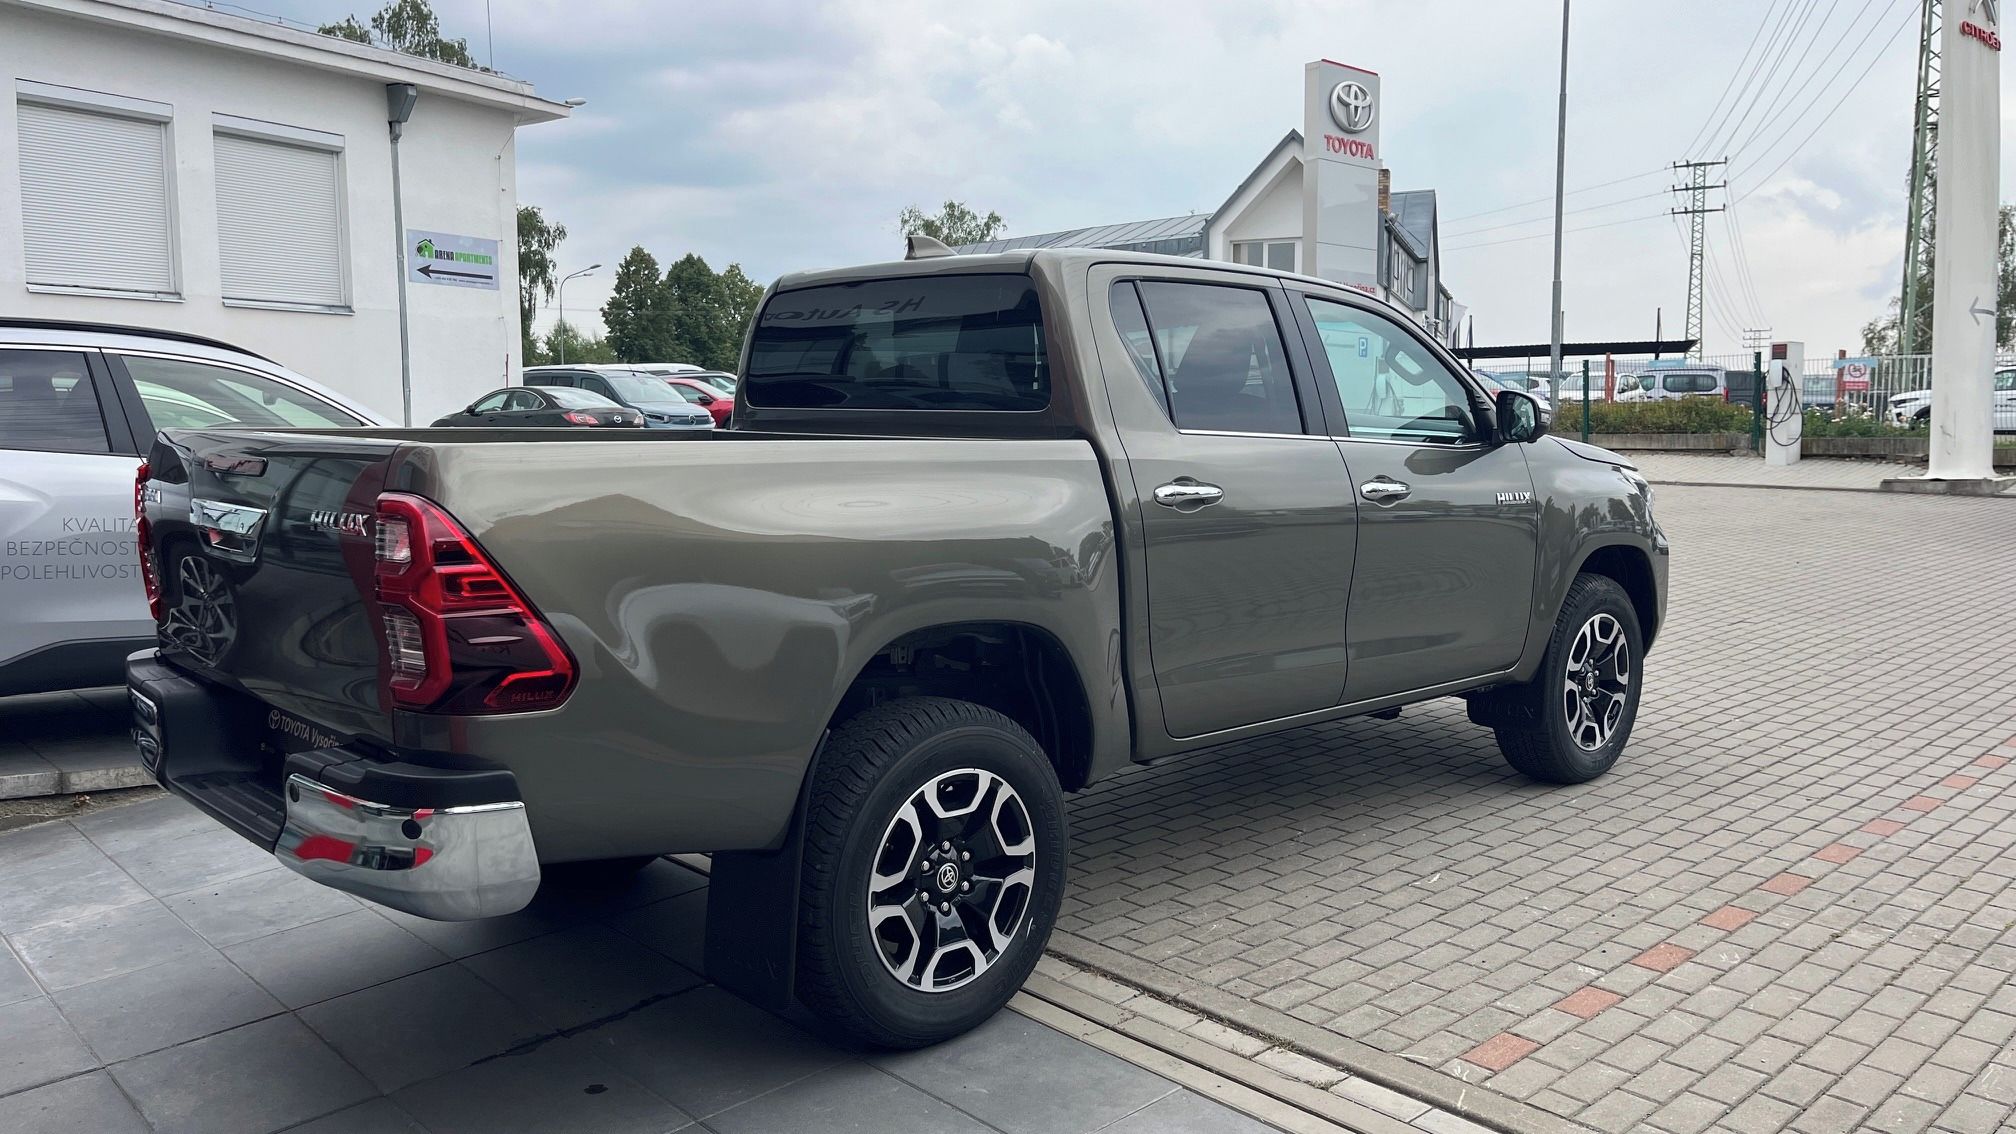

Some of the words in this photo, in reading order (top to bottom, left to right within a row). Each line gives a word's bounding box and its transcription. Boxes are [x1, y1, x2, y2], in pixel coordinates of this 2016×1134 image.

[1324, 134, 1375, 160] TOYOTA
[1495, 492, 1531, 504] HILUX
[310, 510, 370, 537] HILUX
[281, 715, 310, 741] TOYOTA
